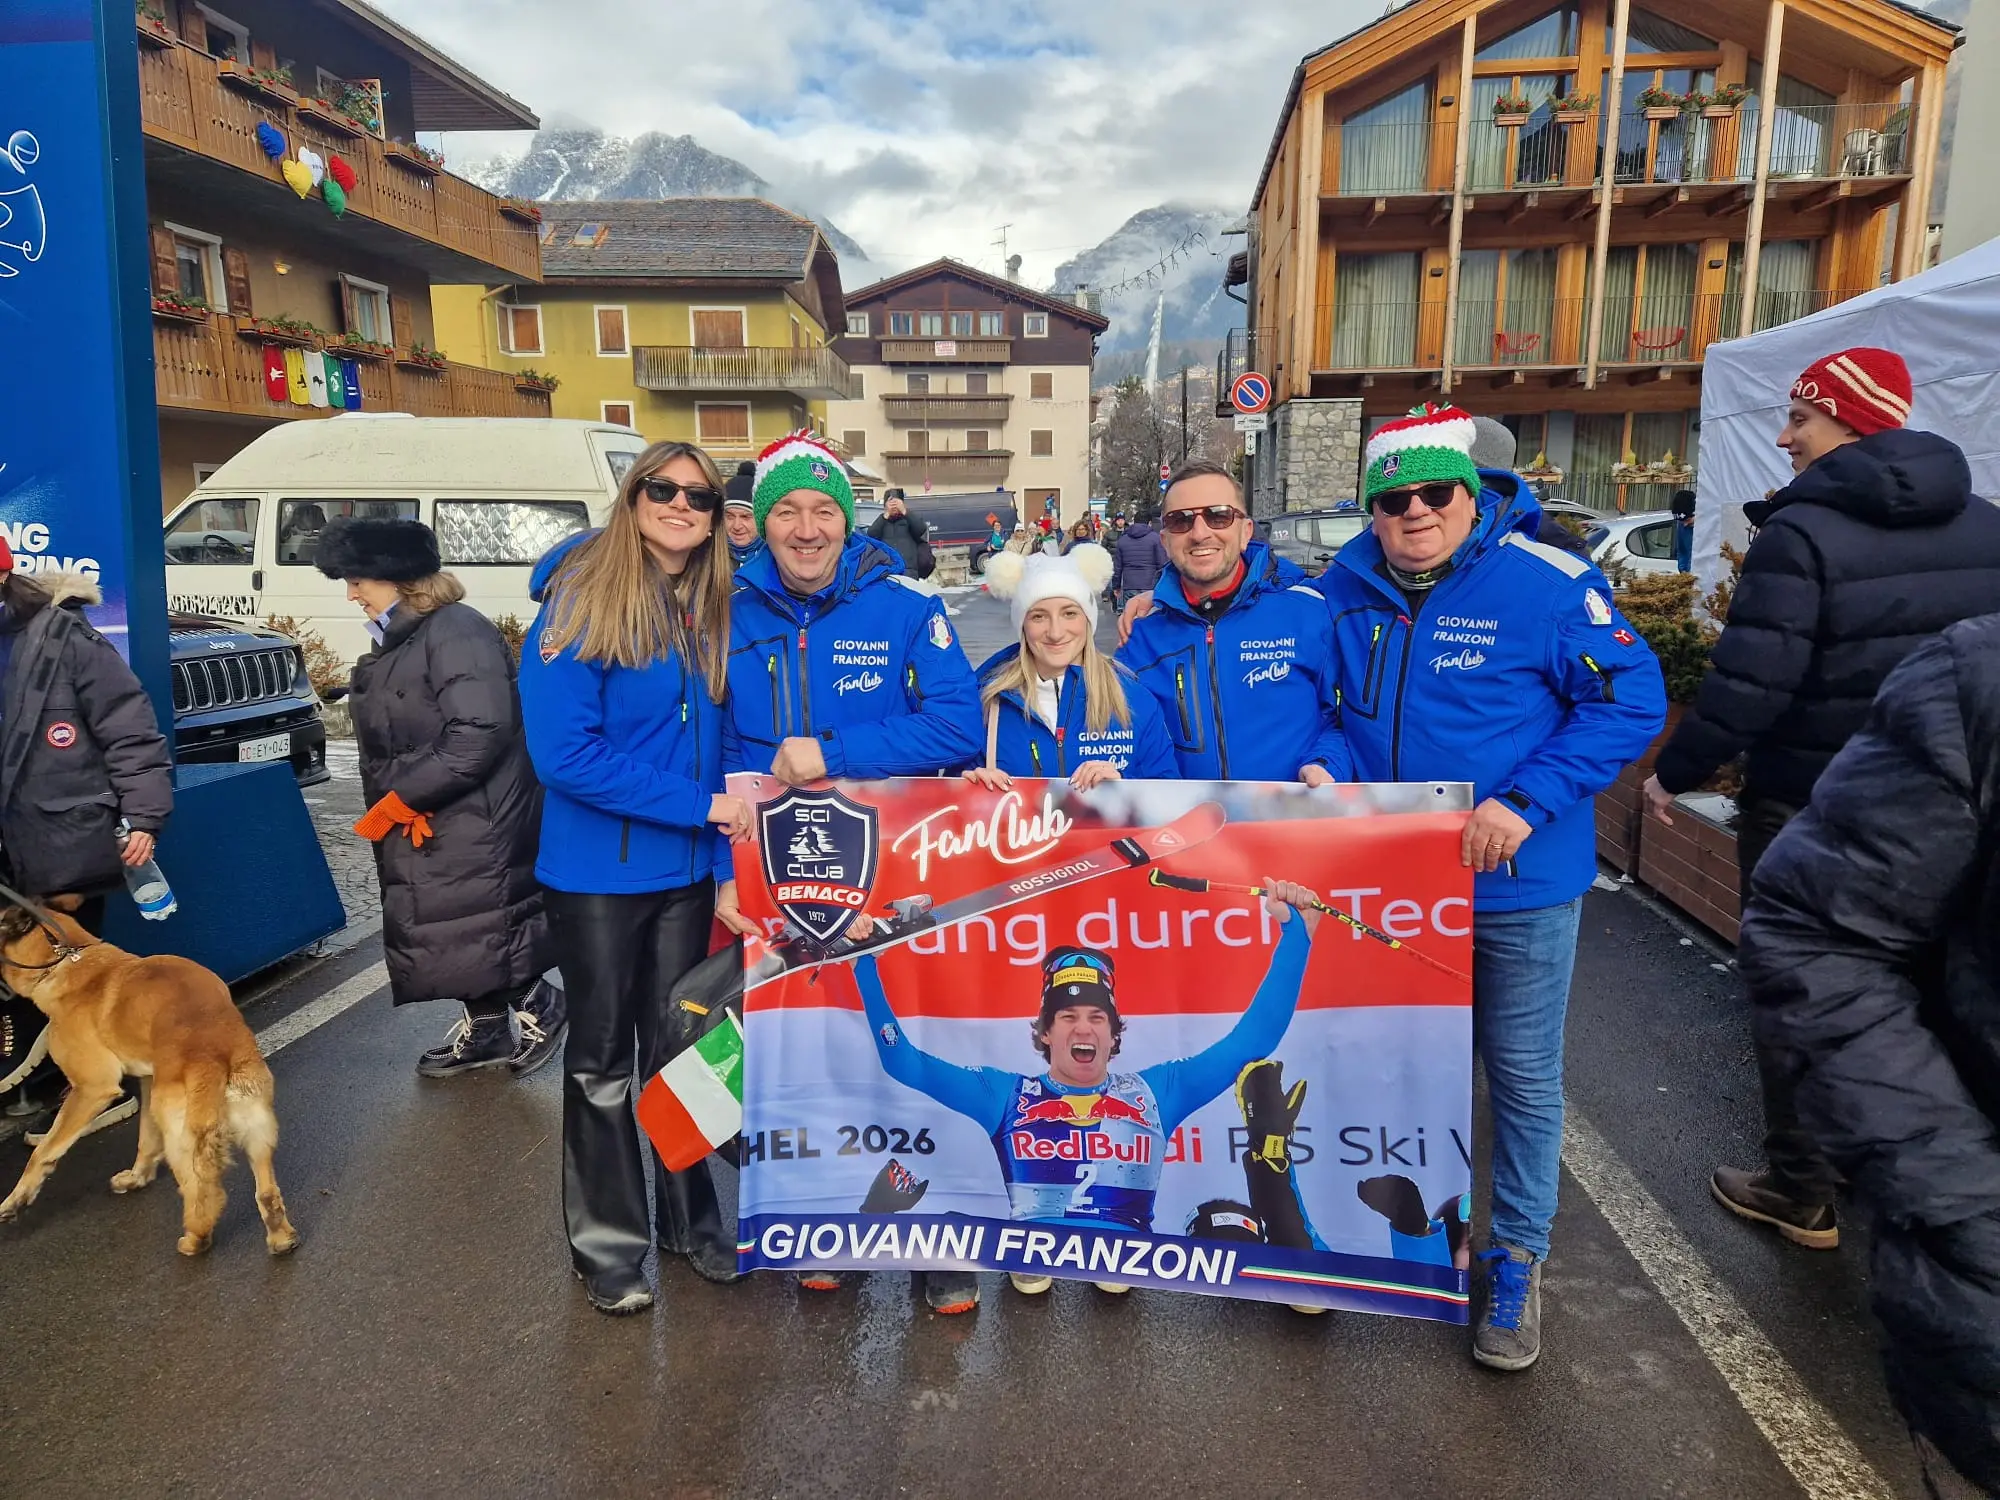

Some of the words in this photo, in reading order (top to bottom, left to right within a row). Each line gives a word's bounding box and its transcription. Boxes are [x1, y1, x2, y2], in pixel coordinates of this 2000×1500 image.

[1273, 530, 1289, 539] 112
[1436, 615, 1499, 630] GIOVANNI
[208, 641, 236, 650] Jeep
[833, 640, 889, 651] GIOVANNI
[1240, 637, 1296, 649] GIOVANNI
[1433, 631, 1496, 646] FRANZONI
[833, 654, 888, 666] FRANZONI
[1240, 650, 1296, 662] FRANZONI
[1078, 730, 1134, 742] GIOVANNI
[1078, 745, 1134, 756] FRANZONI
[794, 808, 830, 823] SCI
[786, 863, 844, 880] CLUB
[1009, 858, 1100, 895] ROSSIGNOL
[777, 884, 865, 906] BENACO
[807, 910, 827, 923] 1972
[836, 1124, 937, 1156] 2026
[1339, 1126, 1428, 1167] Ski
[1010, 1130, 1083, 1161] Red
[1086, 1132, 1153, 1165] Bull
[1071, 1163, 1098, 1208] 2
[760, 1221, 987, 1261] GIOVANNI
[994, 1228, 1238, 1286] FRANZONI
